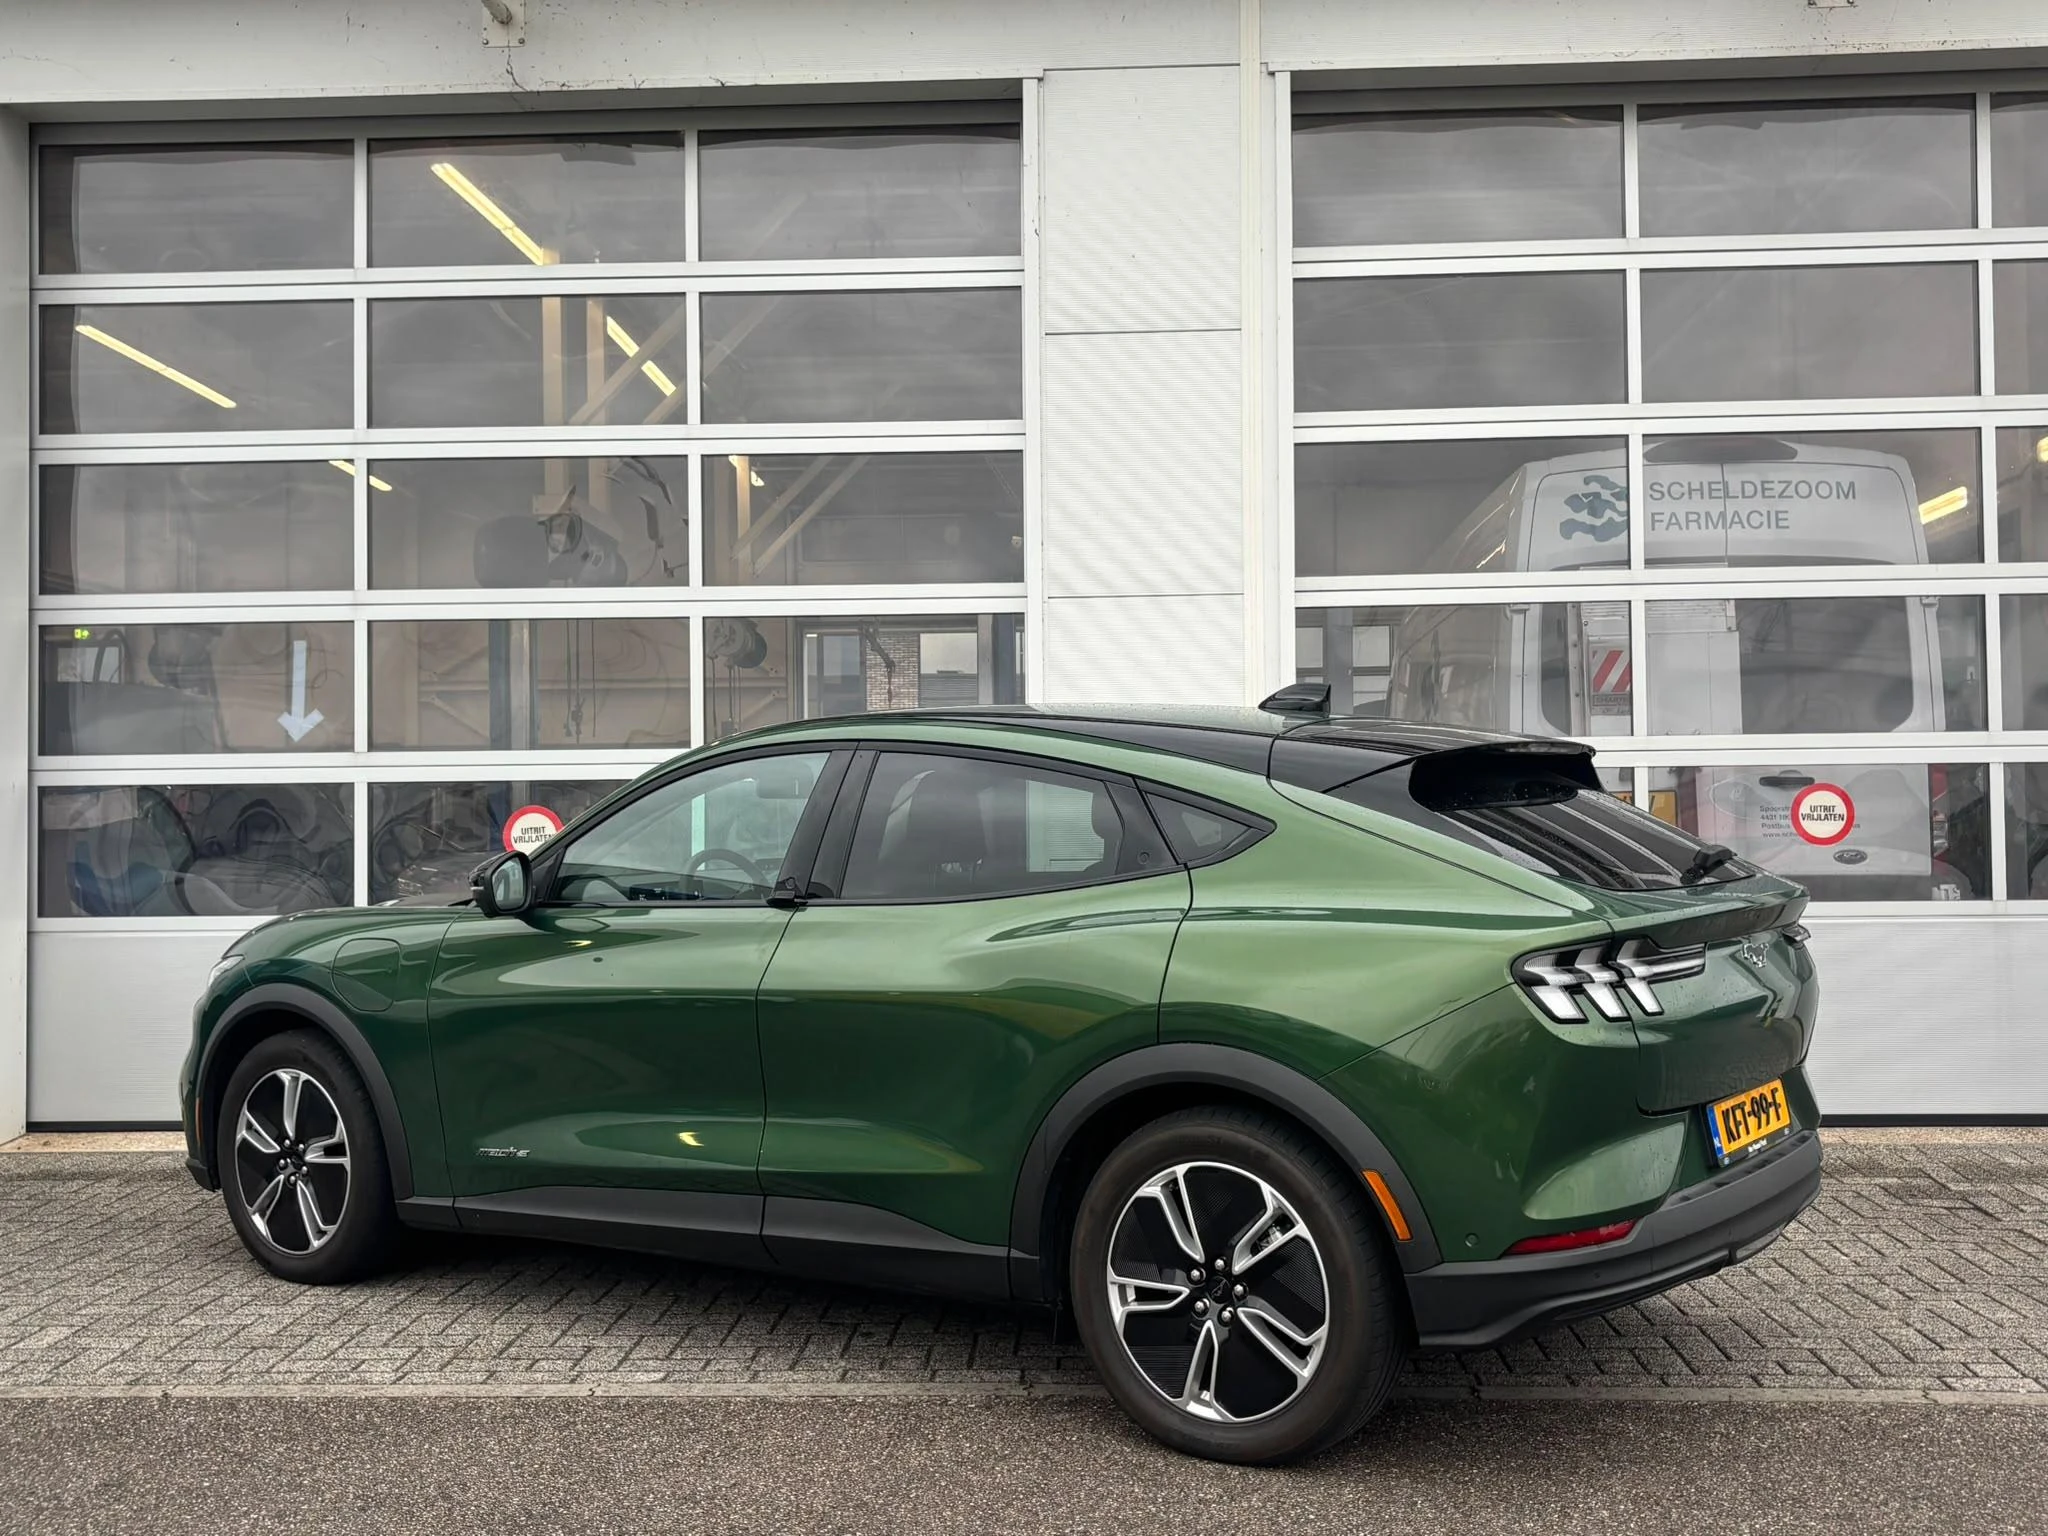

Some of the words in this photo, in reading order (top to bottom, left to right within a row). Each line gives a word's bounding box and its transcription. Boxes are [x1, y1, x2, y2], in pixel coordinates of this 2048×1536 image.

[1649, 480, 1856, 501] SCHELDEZOOM
[1651, 510, 1790, 531] FARMACIE
[1810, 805, 1836, 813] UITRIT
[1801, 813, 1845, 822] VRIJLATEN
[521, 826, 546, 835] UITRIT
[1721, 1087, 1781, 1145] KFT-99-F
